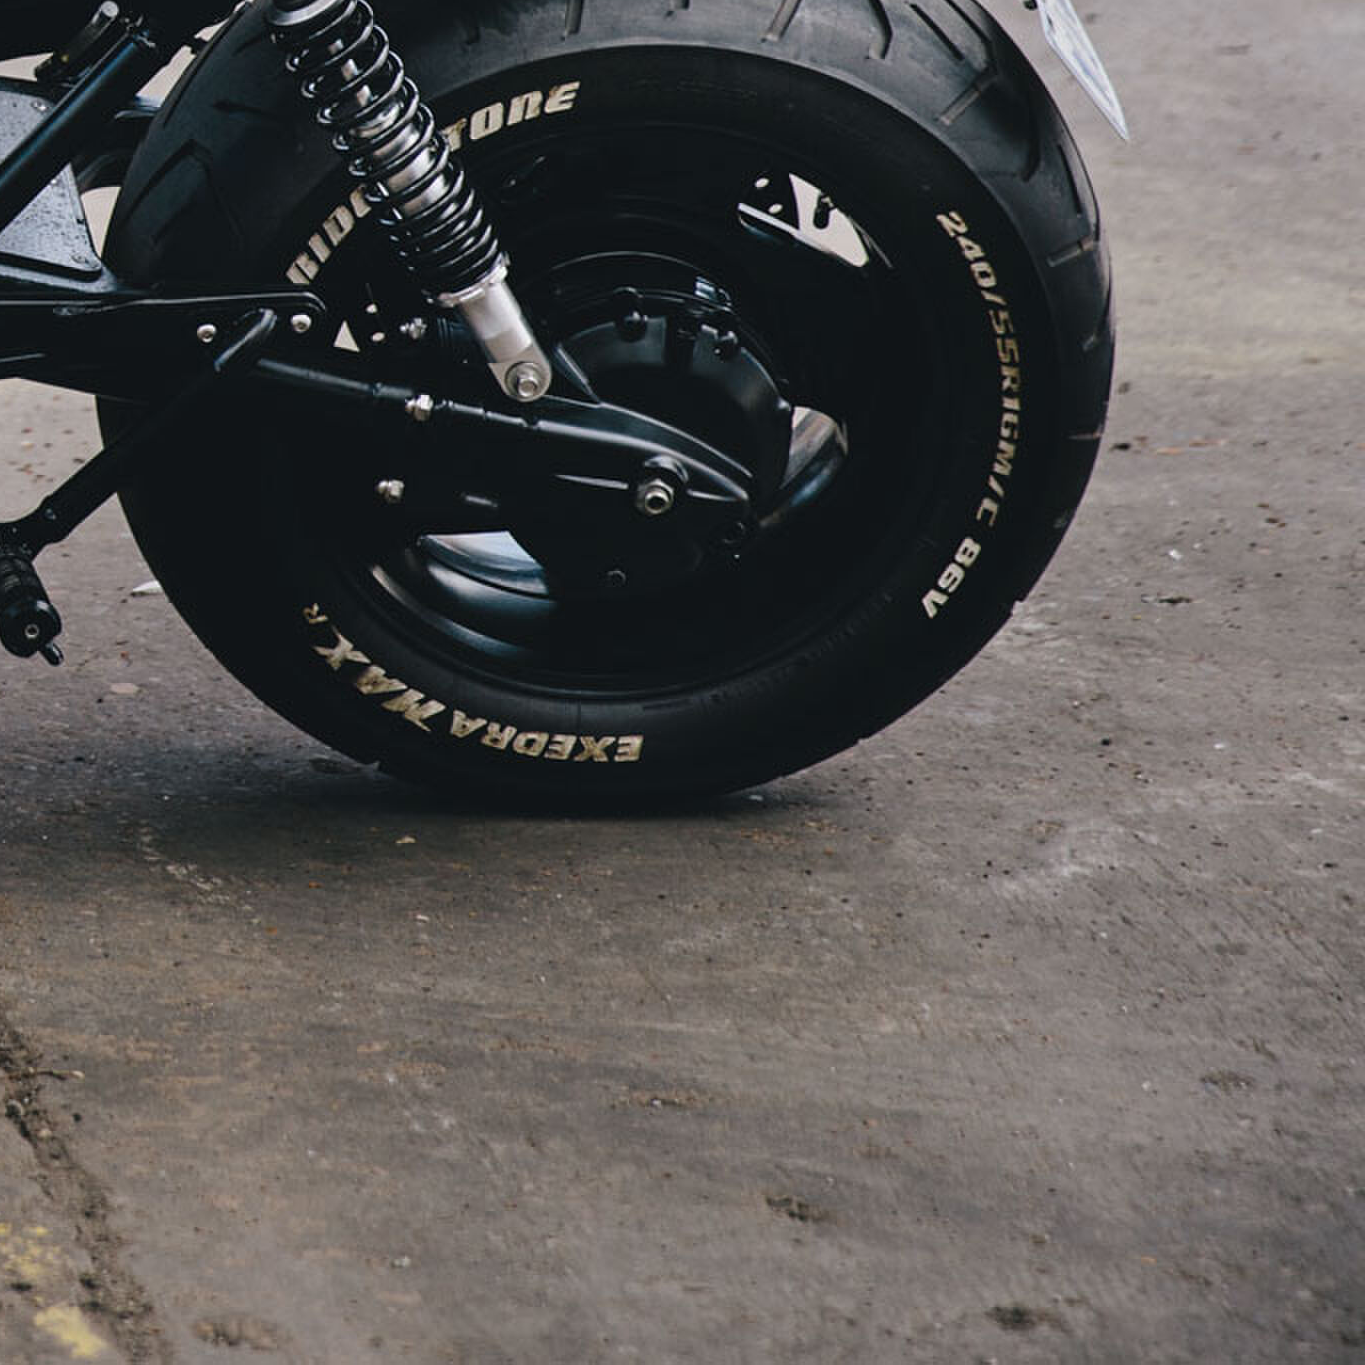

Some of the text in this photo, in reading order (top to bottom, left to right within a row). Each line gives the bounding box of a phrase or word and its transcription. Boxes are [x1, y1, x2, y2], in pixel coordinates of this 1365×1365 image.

[921, 537, 981, 619] 86V
[313, 625, 447, 732] MAX
[450, 709, 645, 763] EXEDRA
